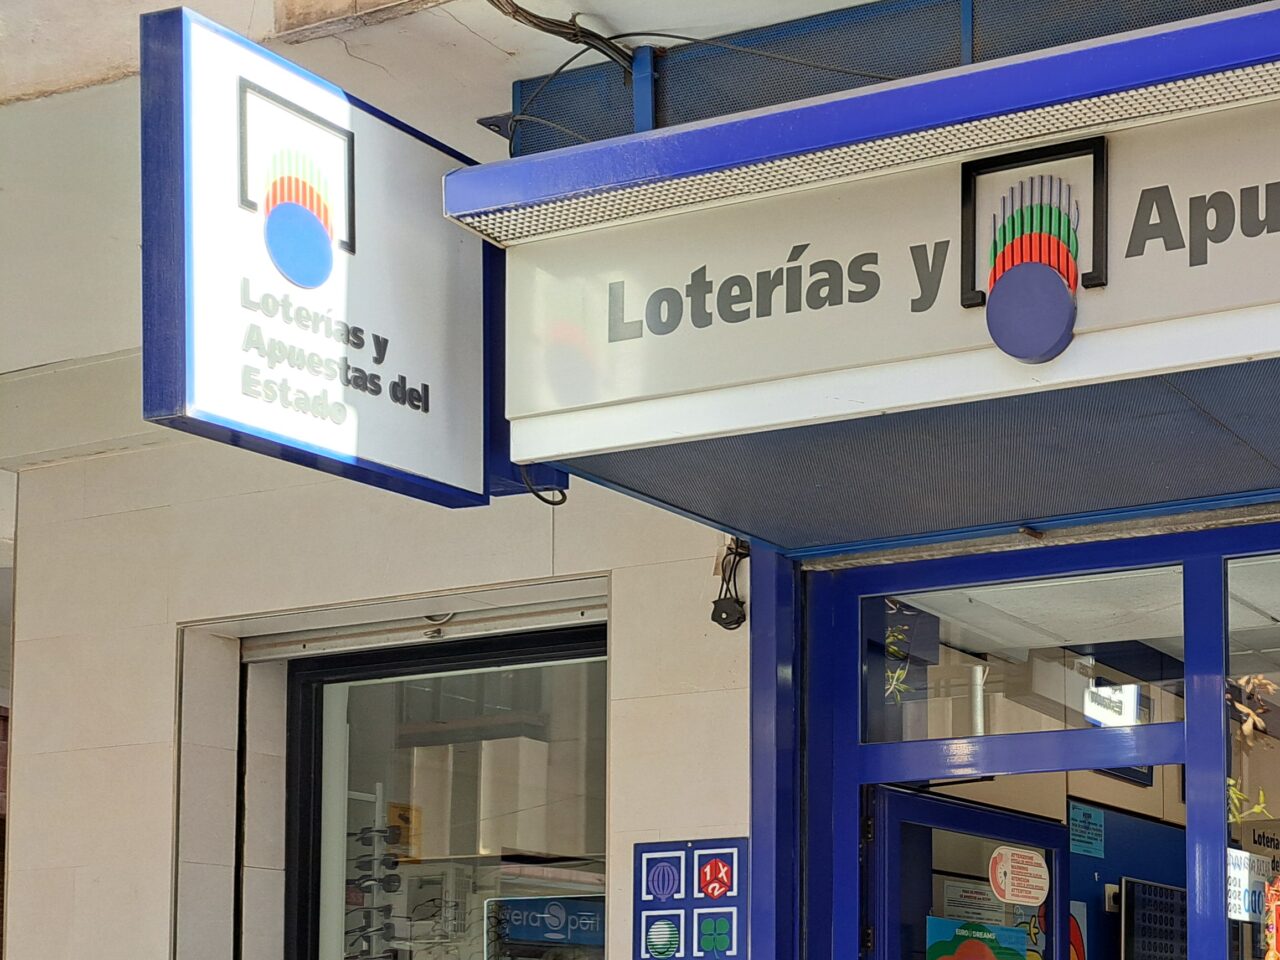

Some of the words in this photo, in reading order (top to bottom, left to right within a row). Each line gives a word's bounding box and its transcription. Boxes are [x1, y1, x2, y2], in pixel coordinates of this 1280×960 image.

[240, 278, 366, 350] Loterías
[372, 333, 389, 365] y
[607, 242, 882, 344] Loterías
[909, 239, 950, 312] y
[241, 364, 348, 425] Estado
[242, 323, 382, 398] Apuestas
[390, 373, 430, 414] del
[1271, 855, 1280, 872] del
